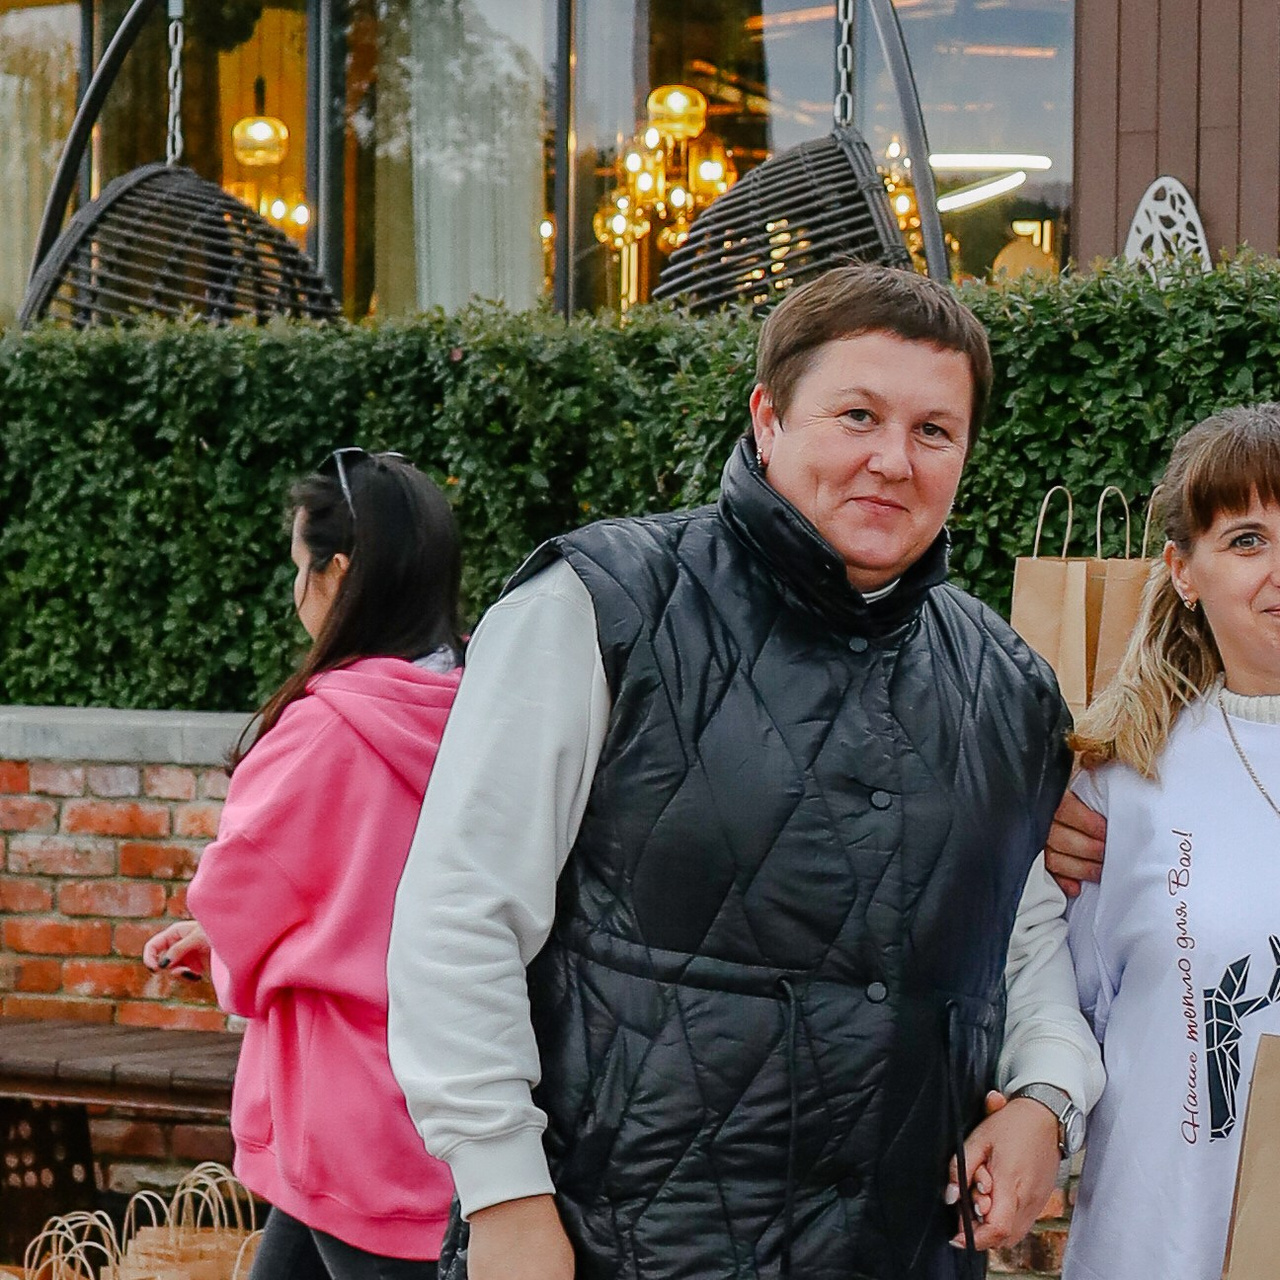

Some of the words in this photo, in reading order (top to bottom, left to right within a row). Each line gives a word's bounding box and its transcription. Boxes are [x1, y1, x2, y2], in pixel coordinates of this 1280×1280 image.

[1168, 829, 1193, 896] Вас!
[1175, 901, 1195, 949] для
[1178, 958, 1198, 1042] тепло
[1181, 1051, 1200, 1144] Наше
